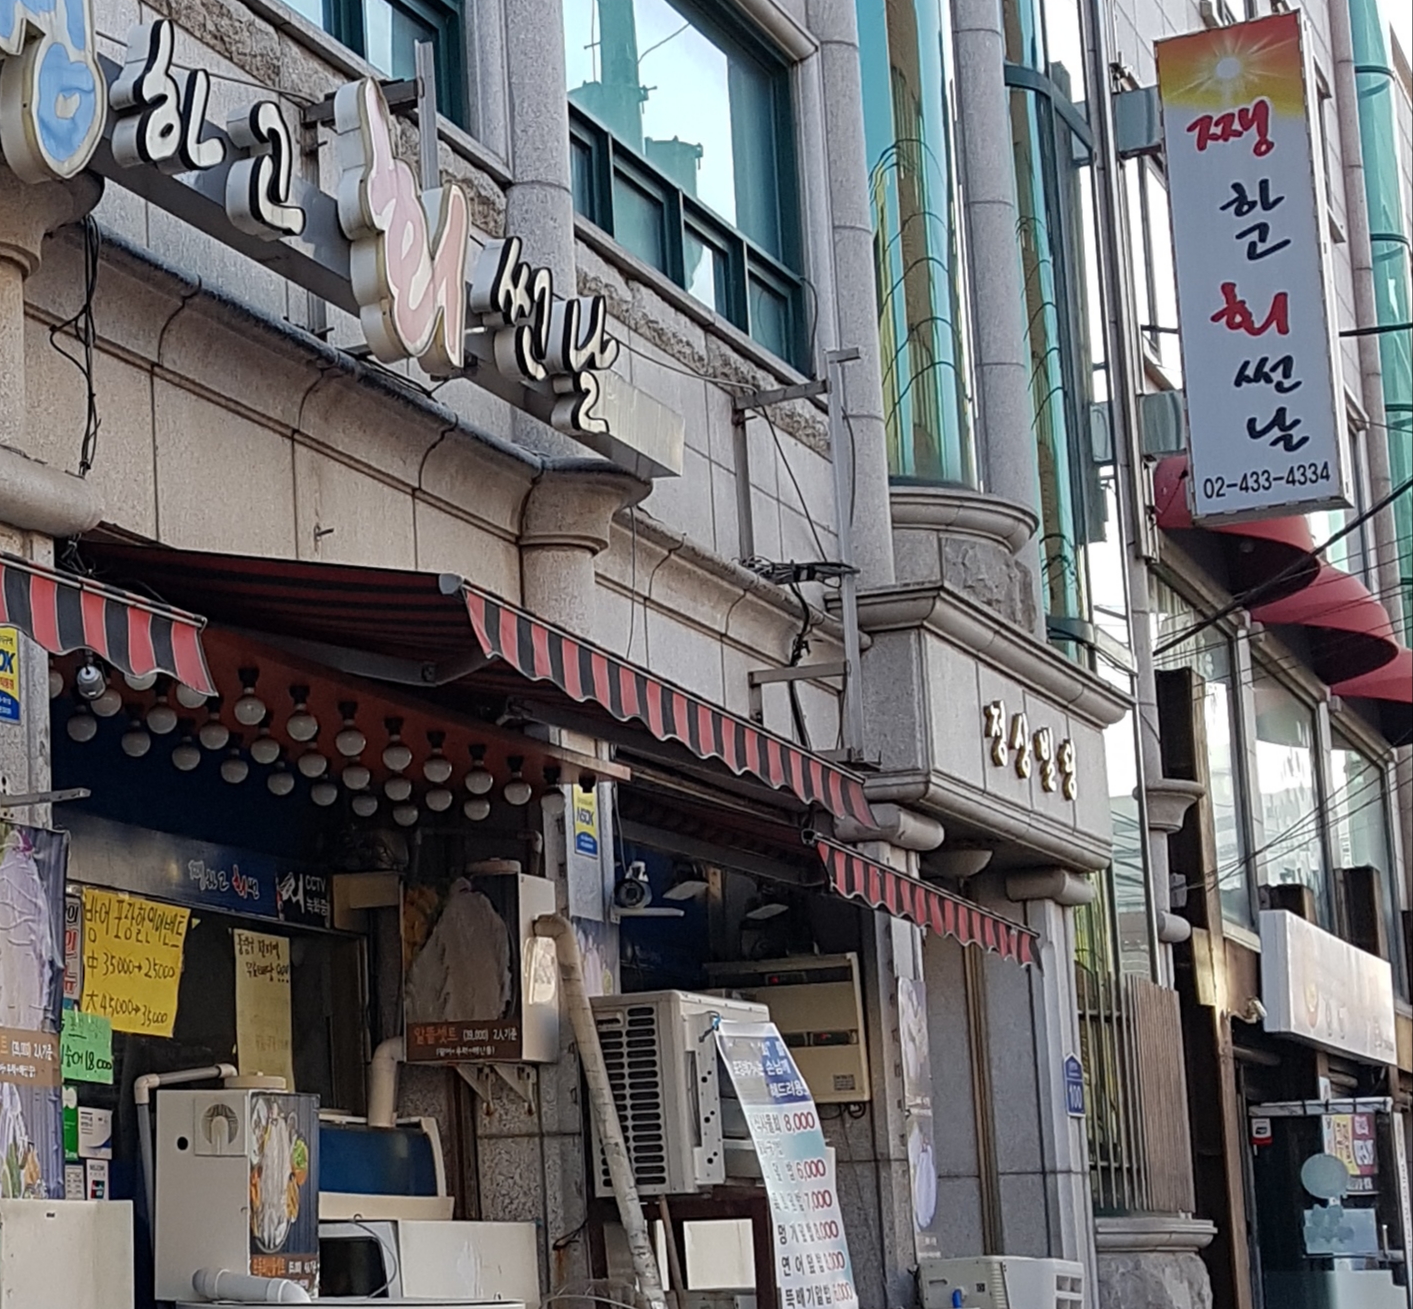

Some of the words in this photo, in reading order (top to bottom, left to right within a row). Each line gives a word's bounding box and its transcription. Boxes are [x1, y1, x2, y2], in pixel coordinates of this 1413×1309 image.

[1203, 460, 1331, 502] 02-433-4334
[305, 874, 326, 893] CCTV
[783, 1111, 815, 1134] 8,000
[796, 1159, 826, 1181] 6,000
